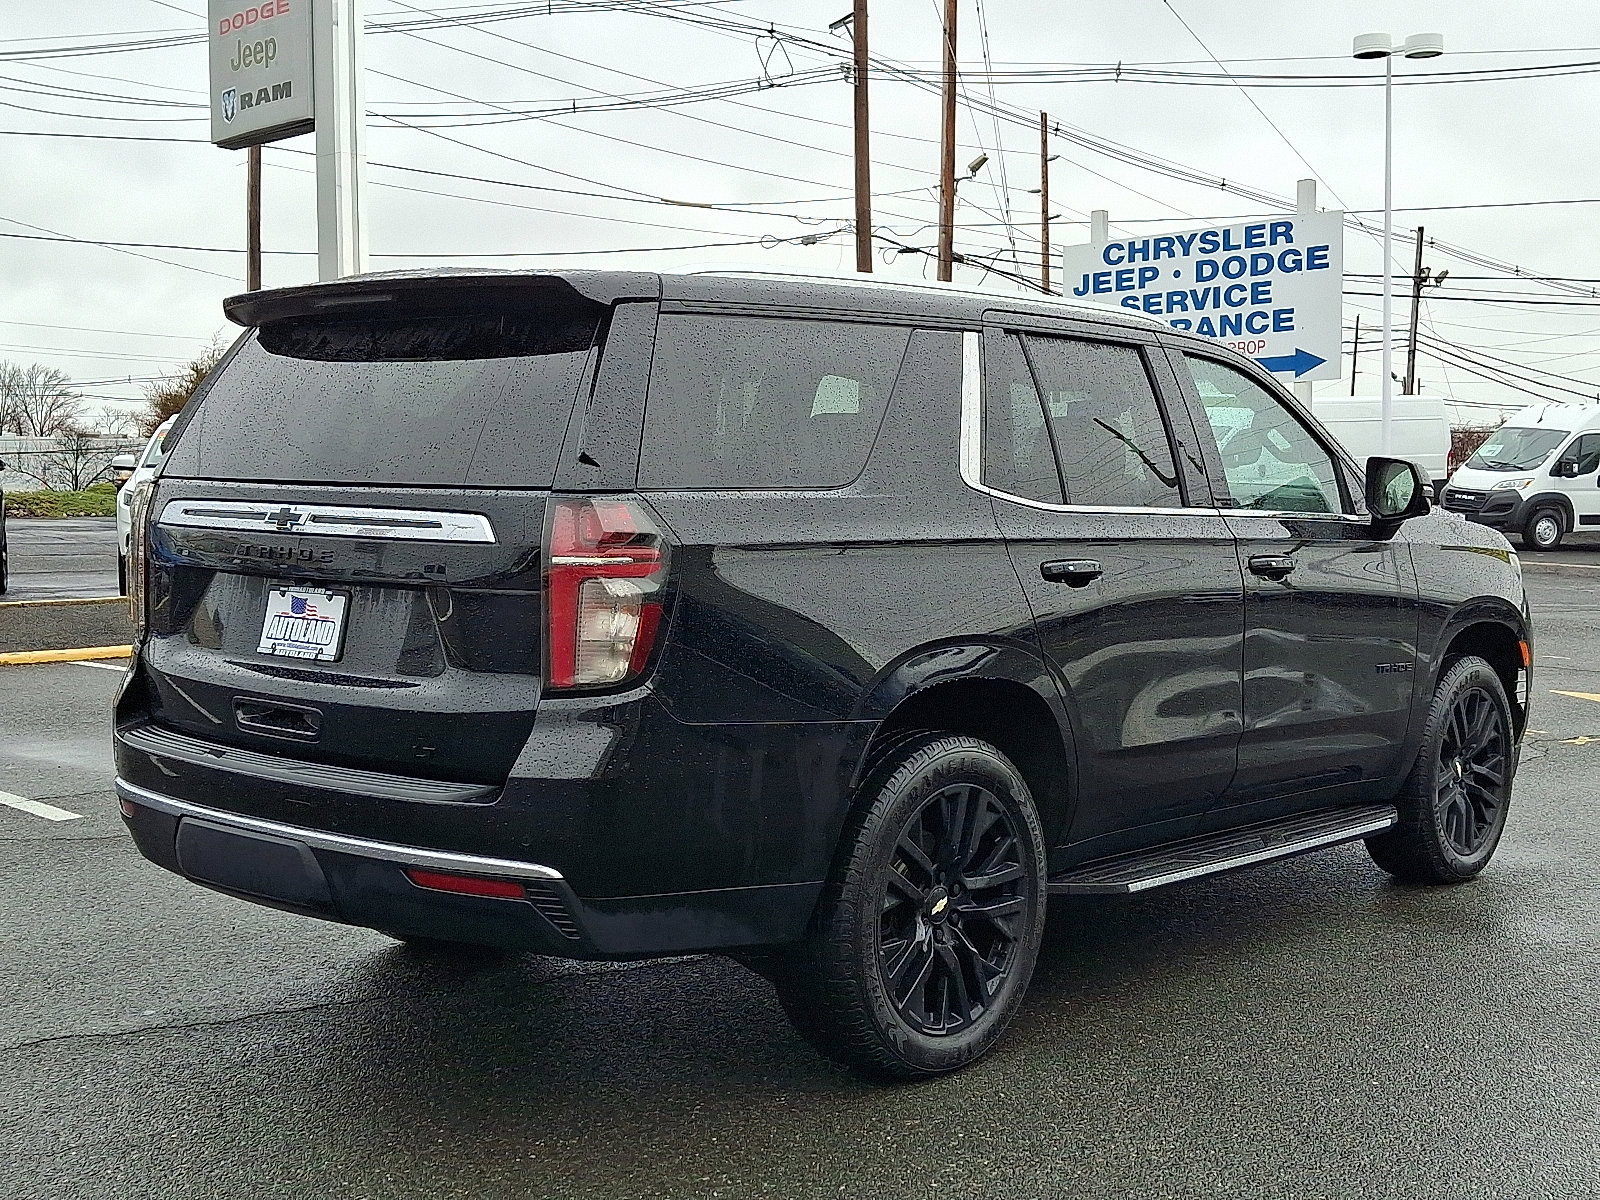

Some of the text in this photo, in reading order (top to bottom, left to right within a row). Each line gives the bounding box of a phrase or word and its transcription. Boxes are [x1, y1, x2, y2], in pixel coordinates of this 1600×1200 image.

[219, 0, 290, 35] DODGE
[231, 37, 277, 71] Jeep
[240, 81, 292, 110] RAM
[1102, 221, 1294, 266] CHRYSLER
[1073, 245, 1330, 297] JEEP DODGE
[1120, 281, 1273, 315] SERVICE
[266, 615, 335, 646] AUTOLAND
[1375, 661, 1413, 674] TAHOE
